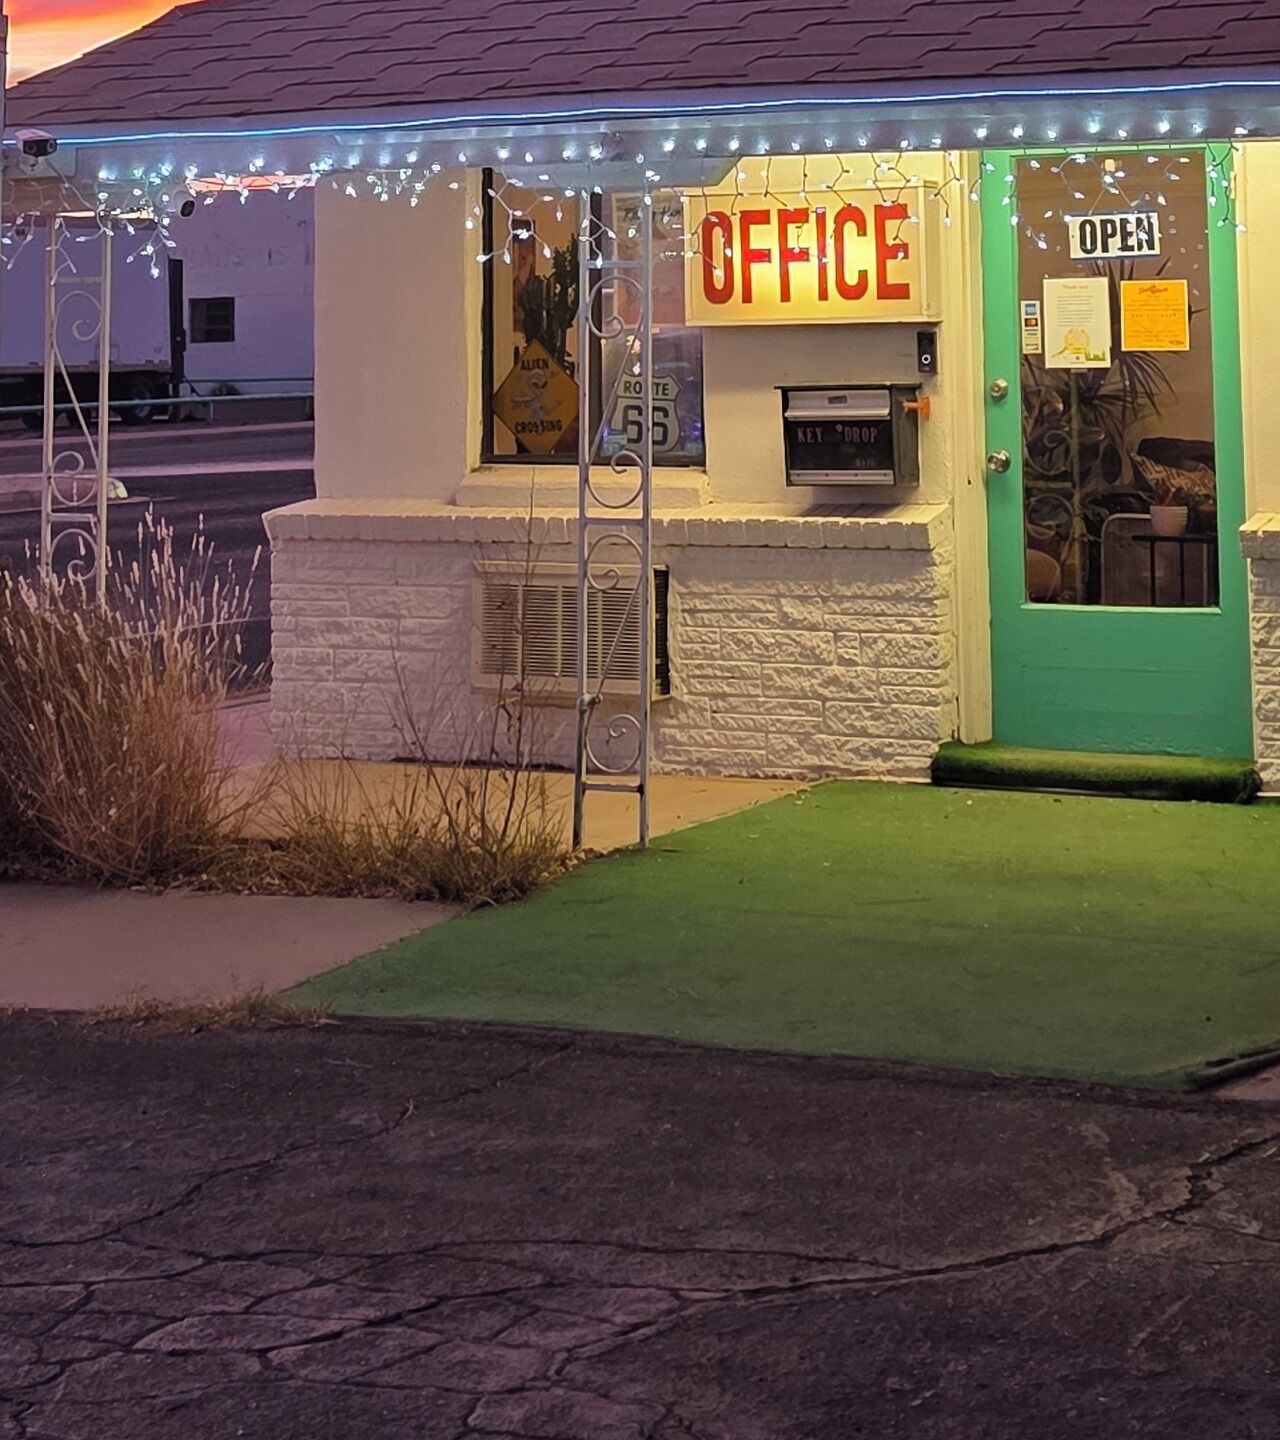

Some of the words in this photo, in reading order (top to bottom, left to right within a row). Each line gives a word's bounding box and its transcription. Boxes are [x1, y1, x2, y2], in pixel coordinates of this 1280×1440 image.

[1079, 215, 1155, 254] OPEN
[701, 203, 912, 305] OFFICE
[521, 358, 549, 371] ALIEN
[623, 380, 669, 396] ROTE
[515, 419, 562, 435] CROSSING
[622, 404, 669, 446] 66
[797, 427, 823, 443] KEY
[844, 426, 878, 443] DROP
